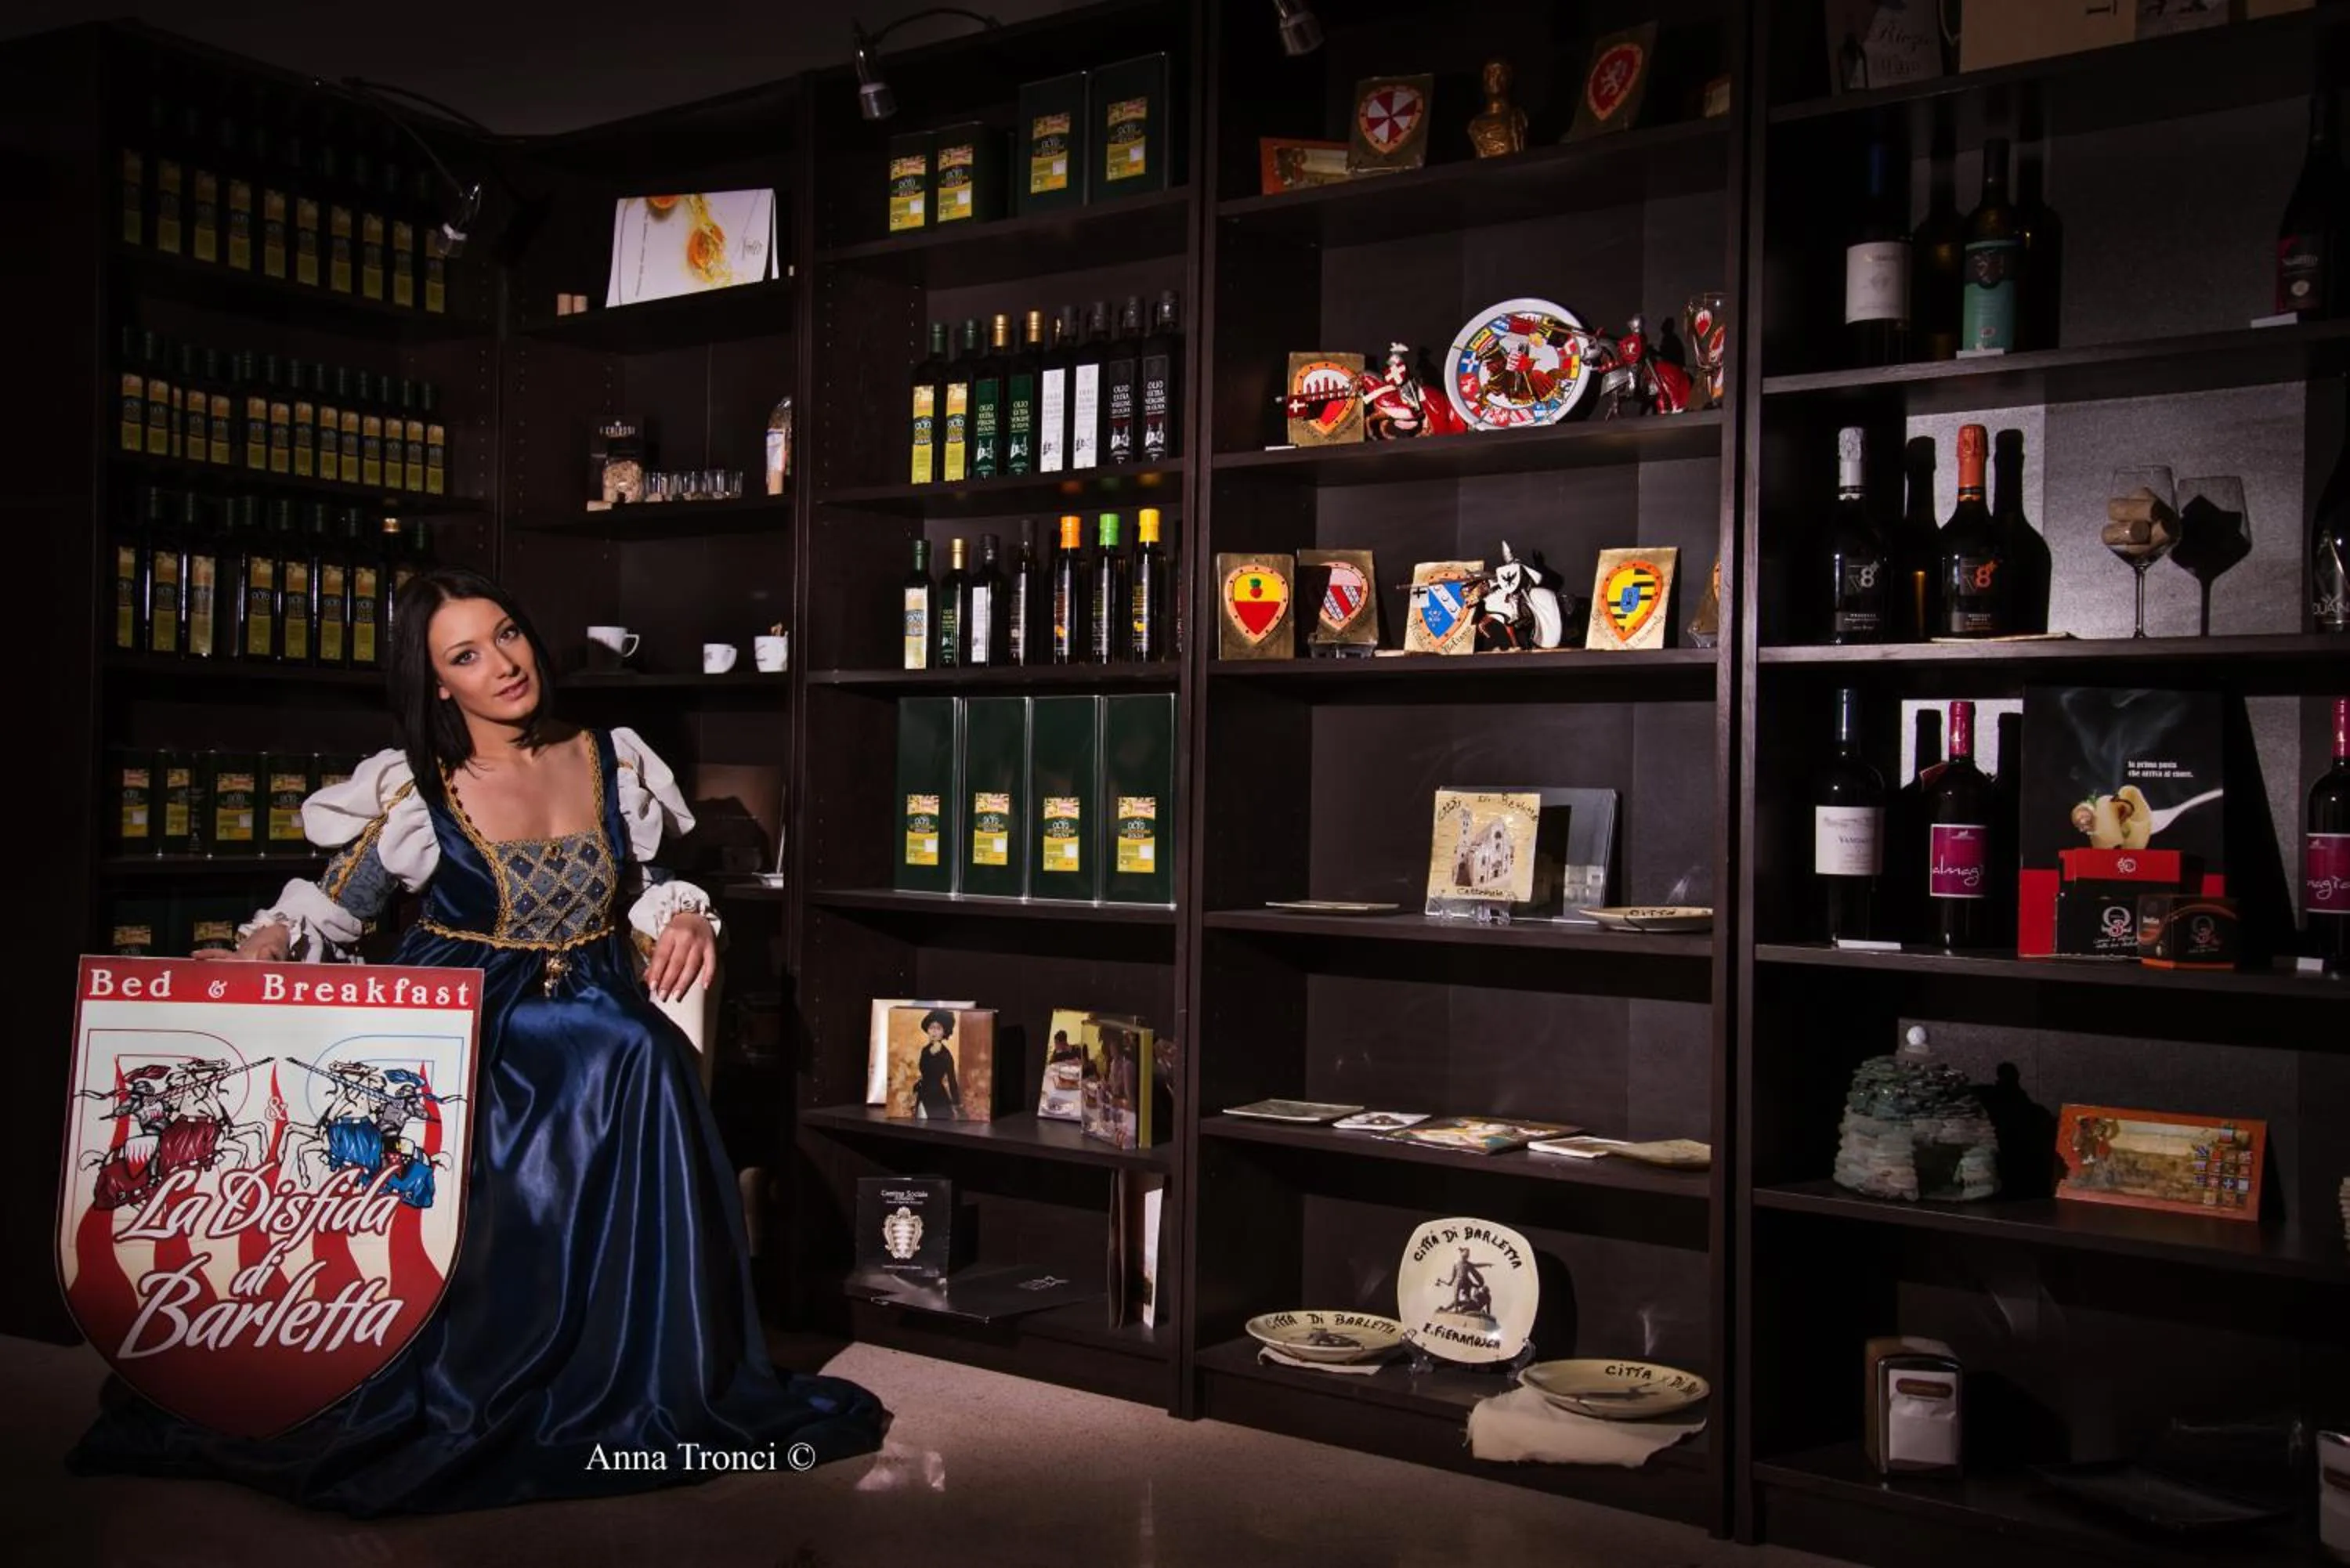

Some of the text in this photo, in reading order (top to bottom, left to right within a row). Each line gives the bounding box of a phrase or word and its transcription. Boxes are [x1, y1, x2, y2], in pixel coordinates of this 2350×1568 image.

[89, 968, 471, 1006] Bed & Breakfast
[114, 1163, 401, 1252] La Disfida
[233, 1240, 289, 1297] di
[1464, 1227, 1523, 1270] BARLETTA
[118, 1253, 404, 1359] Barletta
[1334, 1313, 1397, 1334] BARLETTA
